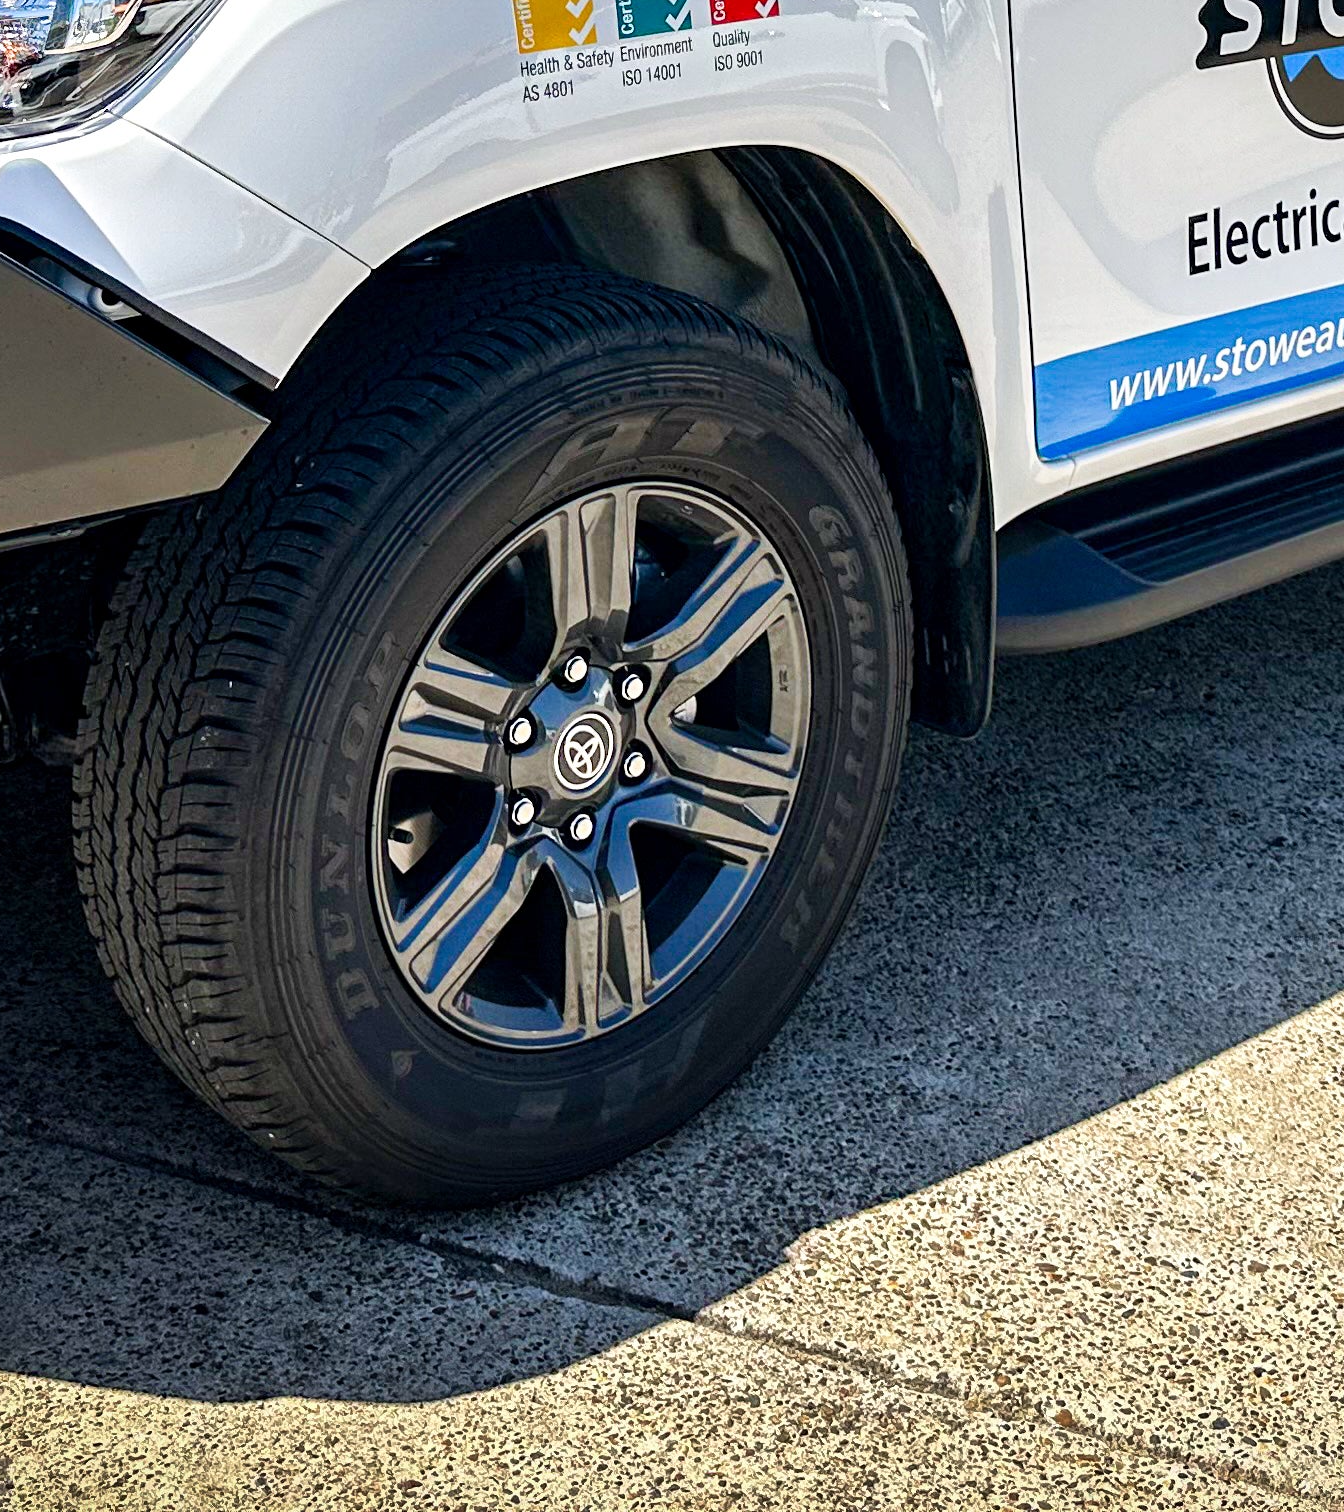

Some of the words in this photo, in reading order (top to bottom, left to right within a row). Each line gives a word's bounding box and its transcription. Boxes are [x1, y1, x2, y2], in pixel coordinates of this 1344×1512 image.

[619, 38, 694, 63] Environment
[712, 30, 751, 49] Quality
[520, 58, 560, 79] Health
[564, 56, 573, 70] &
[576, 50, 615, 70] Safety
[713, 55, 734, 72] ISO
[736, 50, 765, 68] 9001
[621, 69, 643, 88] ISO
[646, 62, 683, 84] 14001
[522, 85, 541, 104] AS
[543, 79, 575, 100] 4801
[317, 628, 399, 1023] DUNLOP
